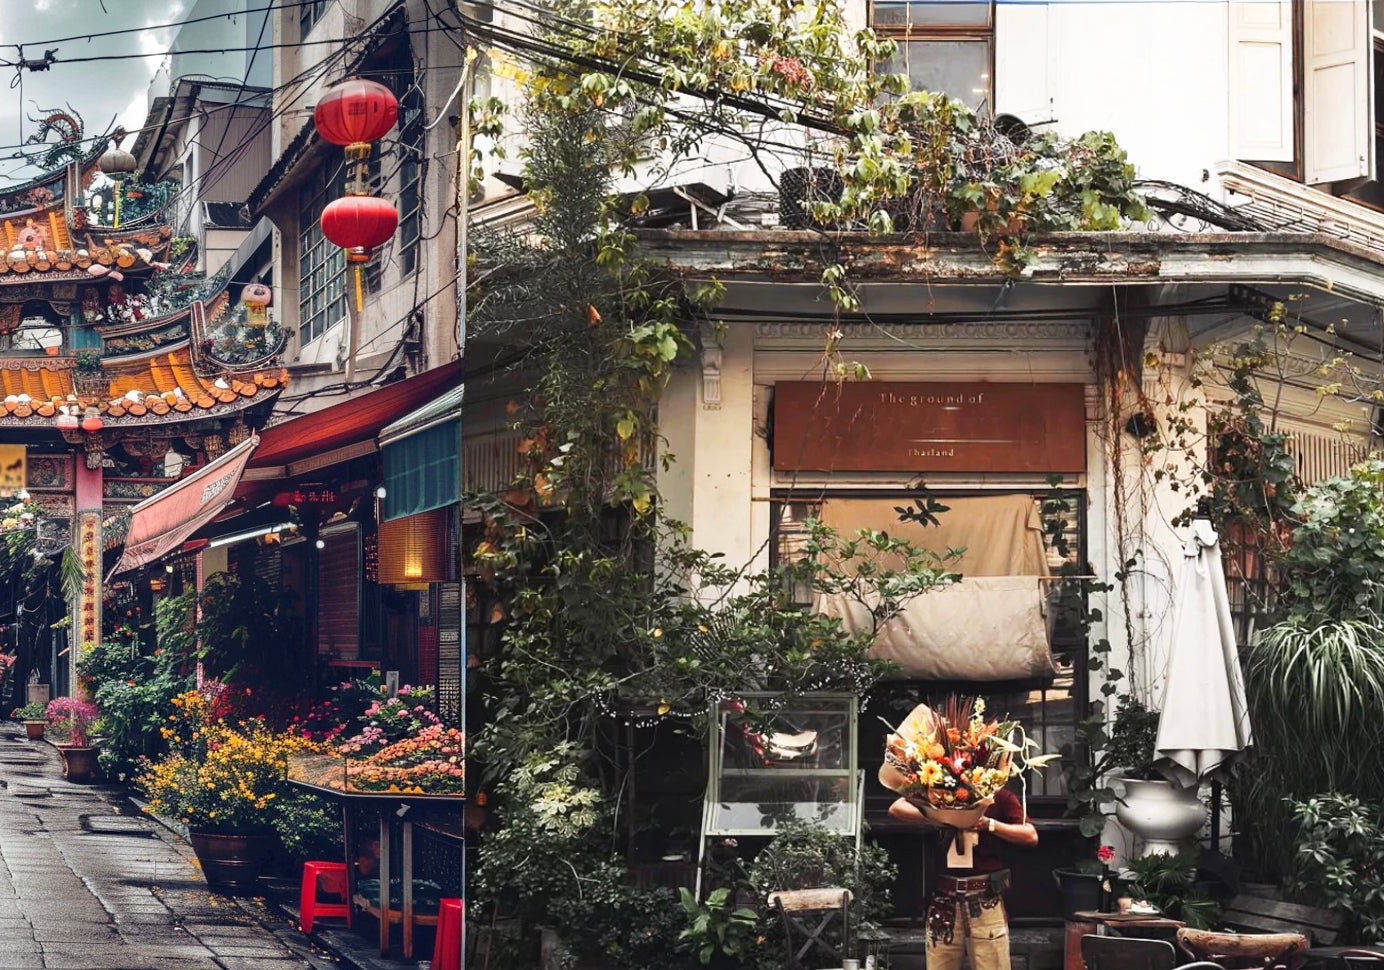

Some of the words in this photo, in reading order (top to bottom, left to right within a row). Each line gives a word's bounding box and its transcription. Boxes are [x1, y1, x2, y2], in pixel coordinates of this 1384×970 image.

[880, 392, 905, 403] The
[910, 393, 964, 407] ground
[968, 392, 984, 403] of
[908, 448, 954, 457] Thailand
